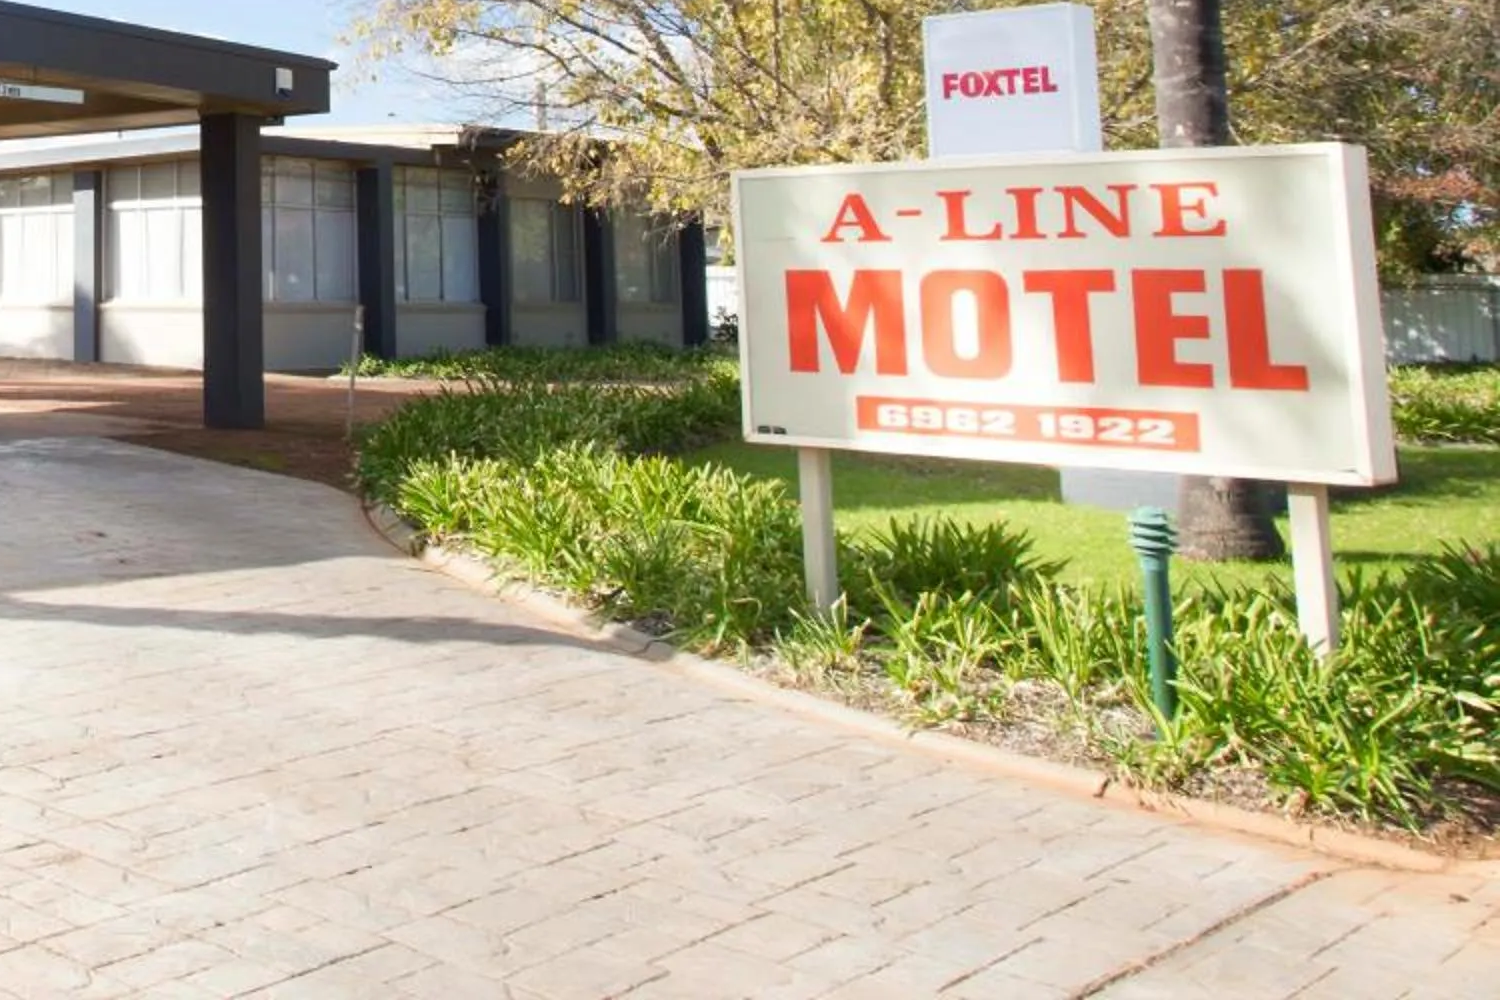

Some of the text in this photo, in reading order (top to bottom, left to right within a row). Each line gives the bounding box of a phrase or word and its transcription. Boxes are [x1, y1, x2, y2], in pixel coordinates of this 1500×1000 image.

[942, 66, 1057, 98] FOXTEL
[821, 182, 1228, 243] A-LINE
[784, 267, 1310, 391] MOTEL
[1037, 412, 1177, 445] 1922
